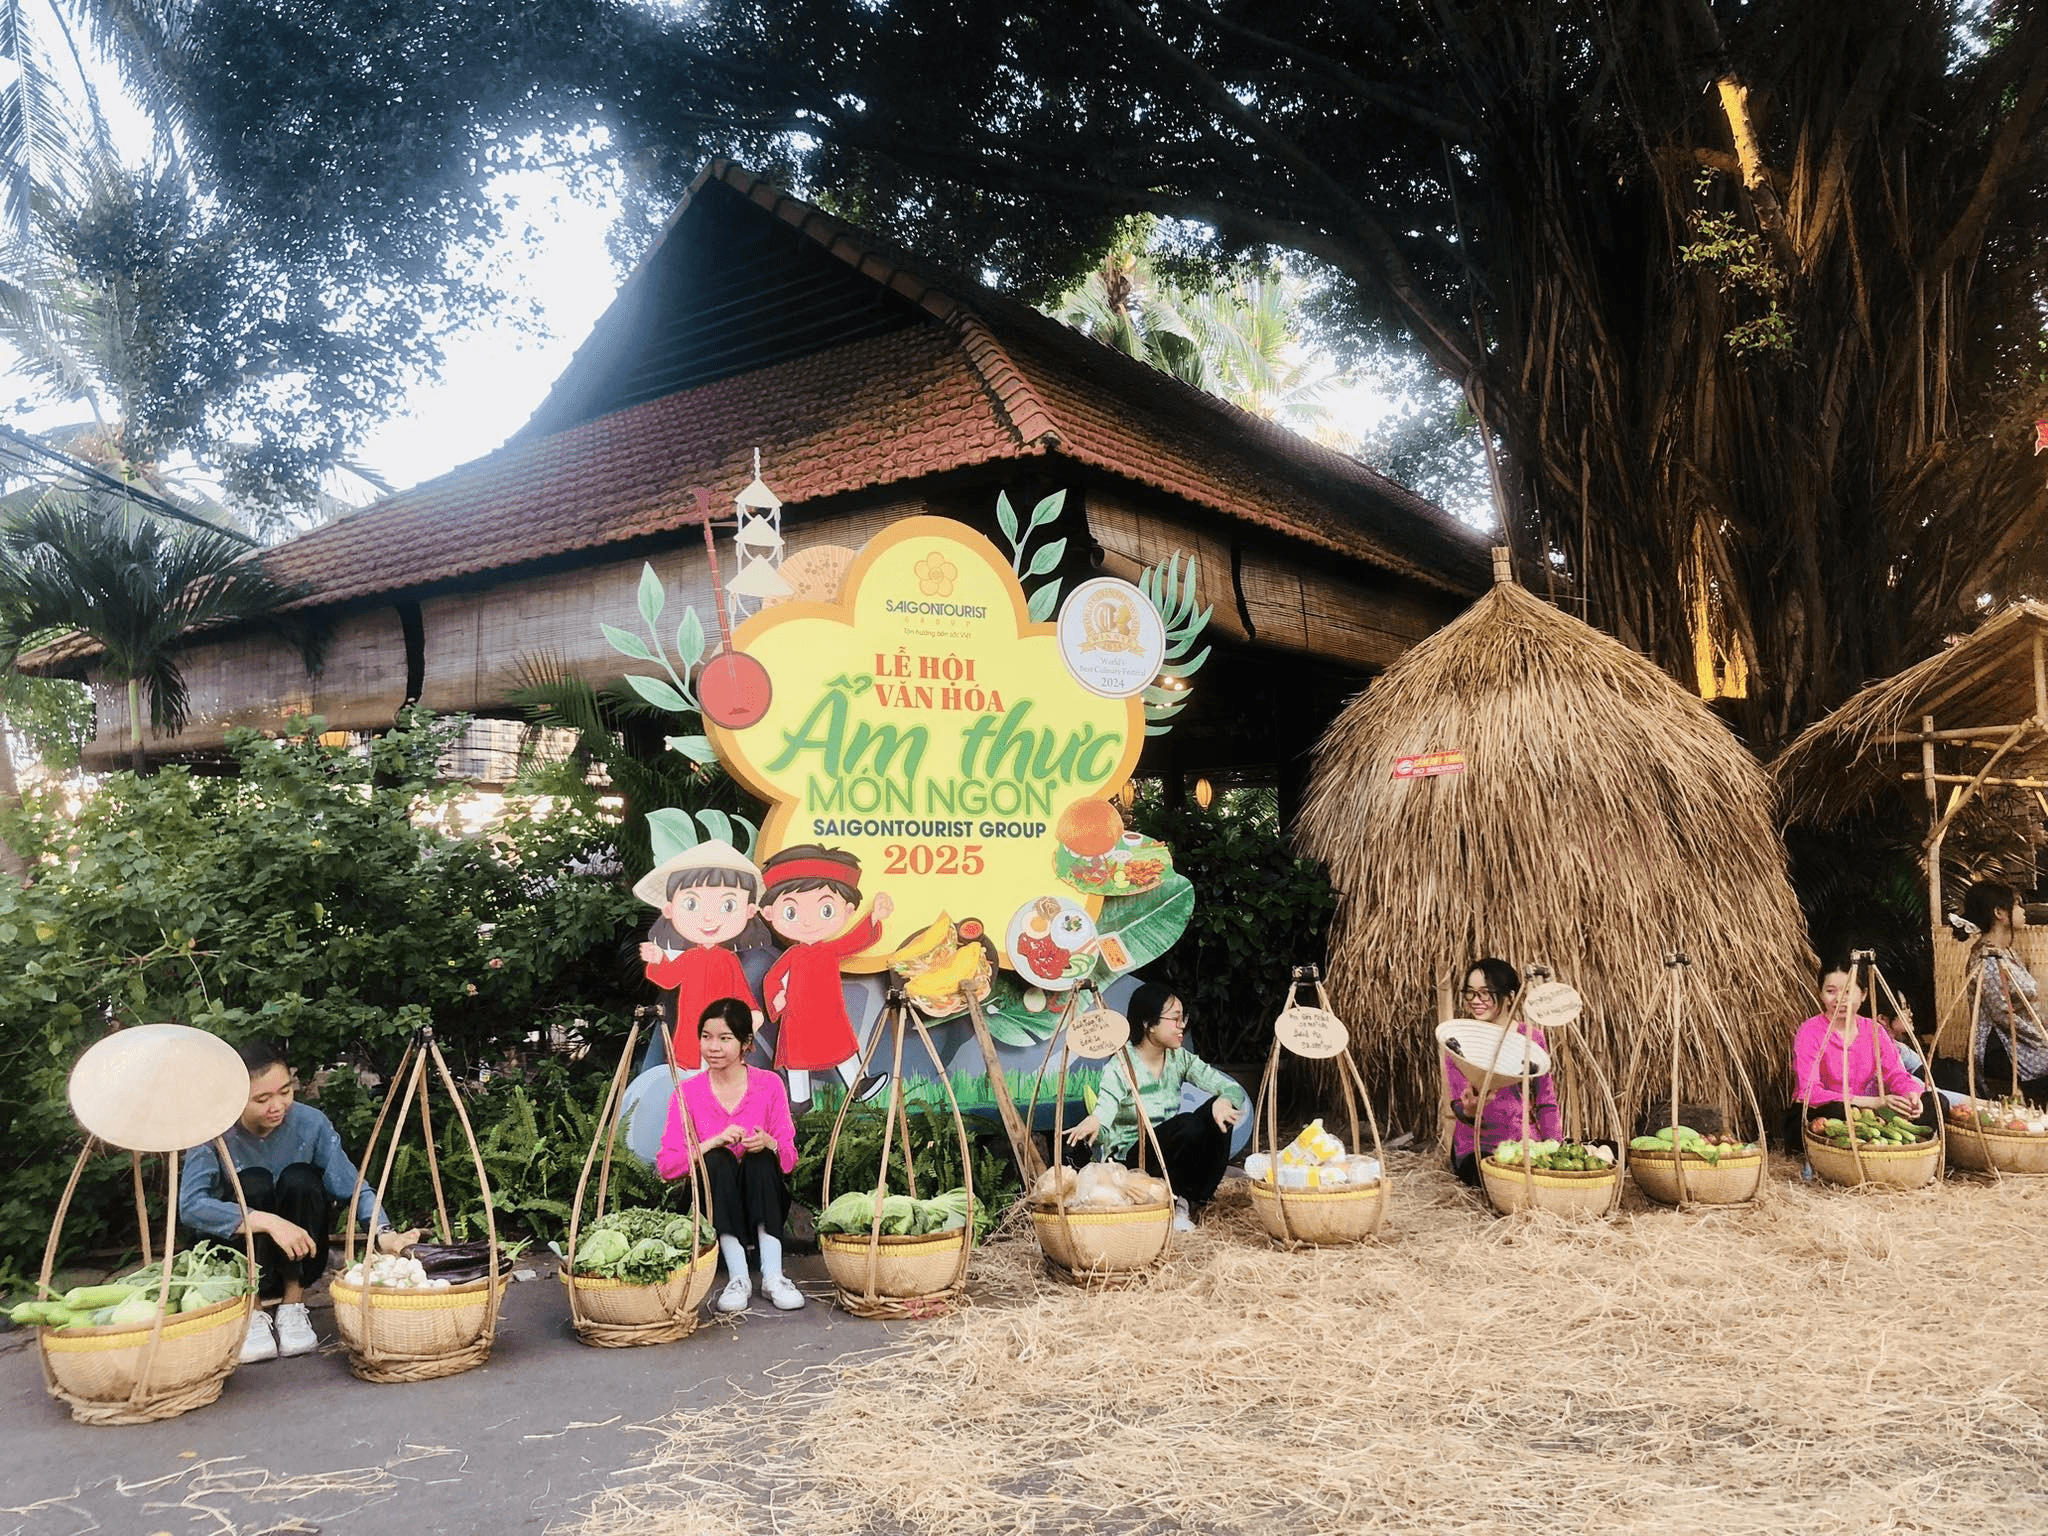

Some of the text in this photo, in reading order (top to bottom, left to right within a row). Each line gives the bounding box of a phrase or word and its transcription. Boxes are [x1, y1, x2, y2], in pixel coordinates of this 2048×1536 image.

[885, 599, 987, 619] SAIGONTOURIST
[874, 646, 976, 686] LỄ HỘI
[874, 681, 1006, 712] VĂN HÓA
[1101, 676, 1125, 688] 2024
[766, 675, 1121, 790] Ẩm thực
[809, 767, 1051, 816] MÓN NGON
[813, 819, 1047, 839] SAIGONTOURIST GROUP
[883, 844, 985, 875] 2025
